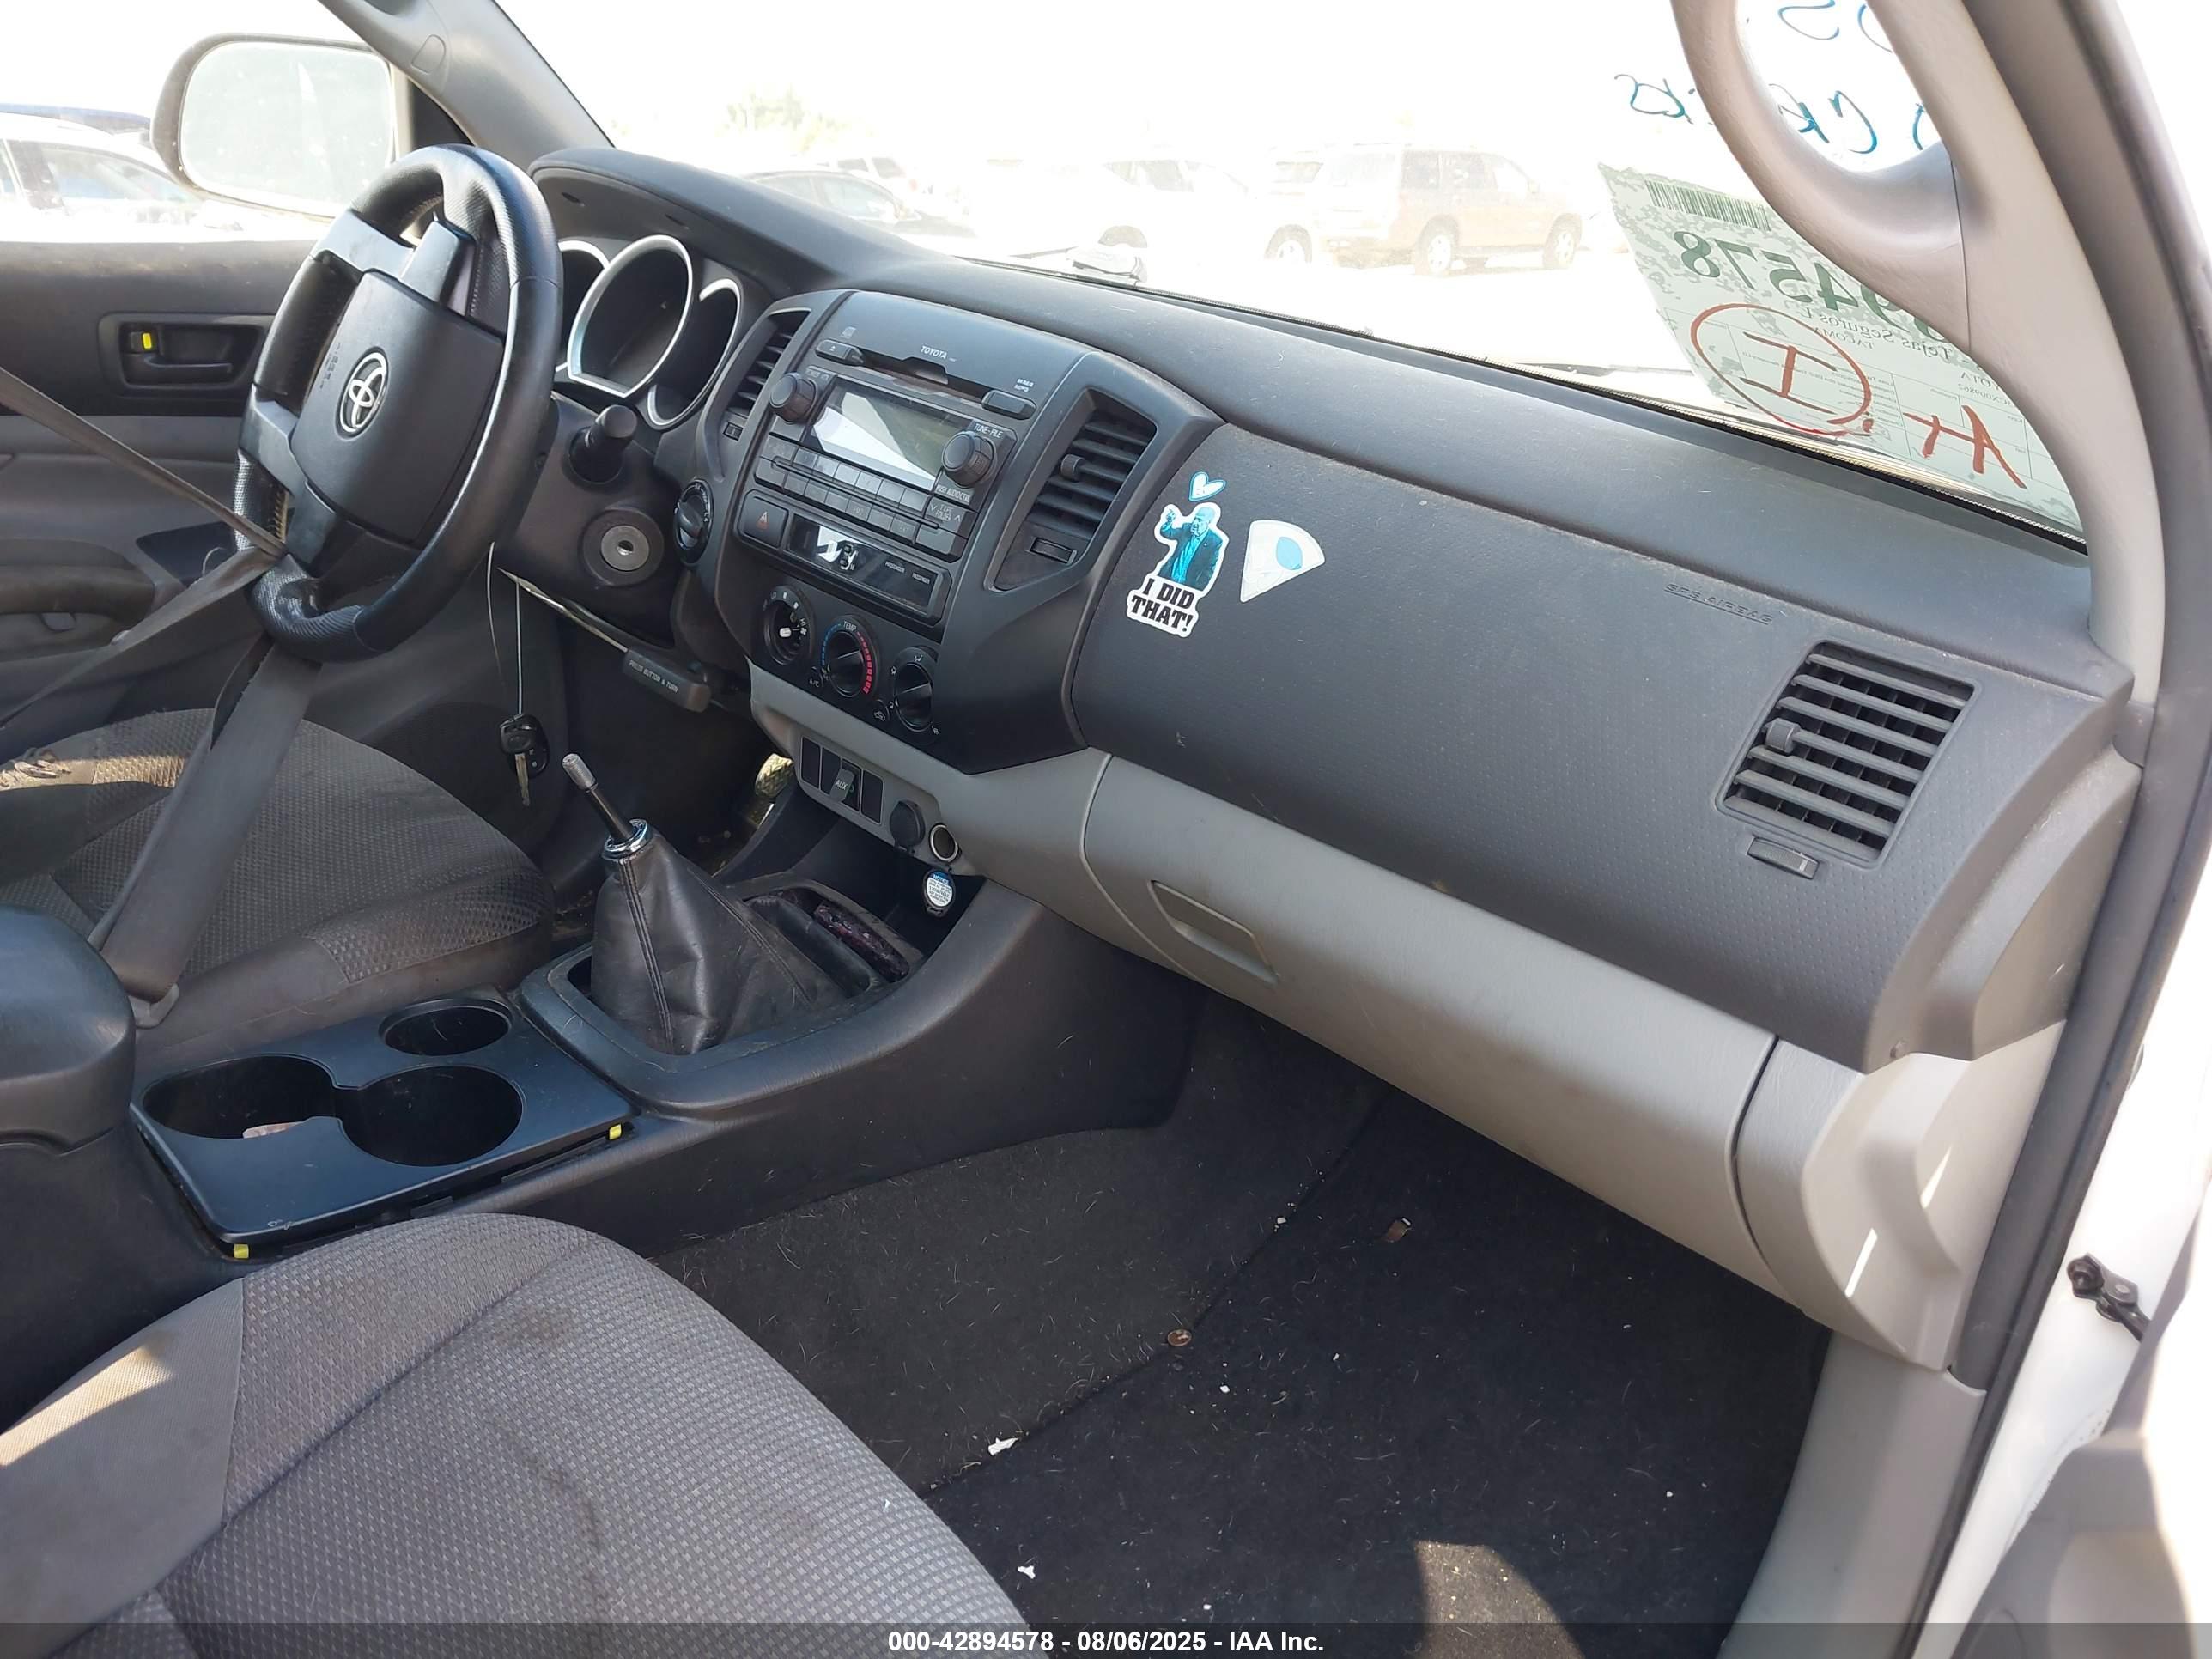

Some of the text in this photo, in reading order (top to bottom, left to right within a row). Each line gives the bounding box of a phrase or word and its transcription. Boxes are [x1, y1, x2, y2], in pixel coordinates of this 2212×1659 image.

[921, 344, 948, 360] TOYOTA
[1142, 578, 1195, 609] I DID
[1131, 595, 1194, 632] THAT!
[843, 620, 857, 632] TEMP
[809, 678, 820, 688] A/C
[836, 780, 848, 791] AUX
